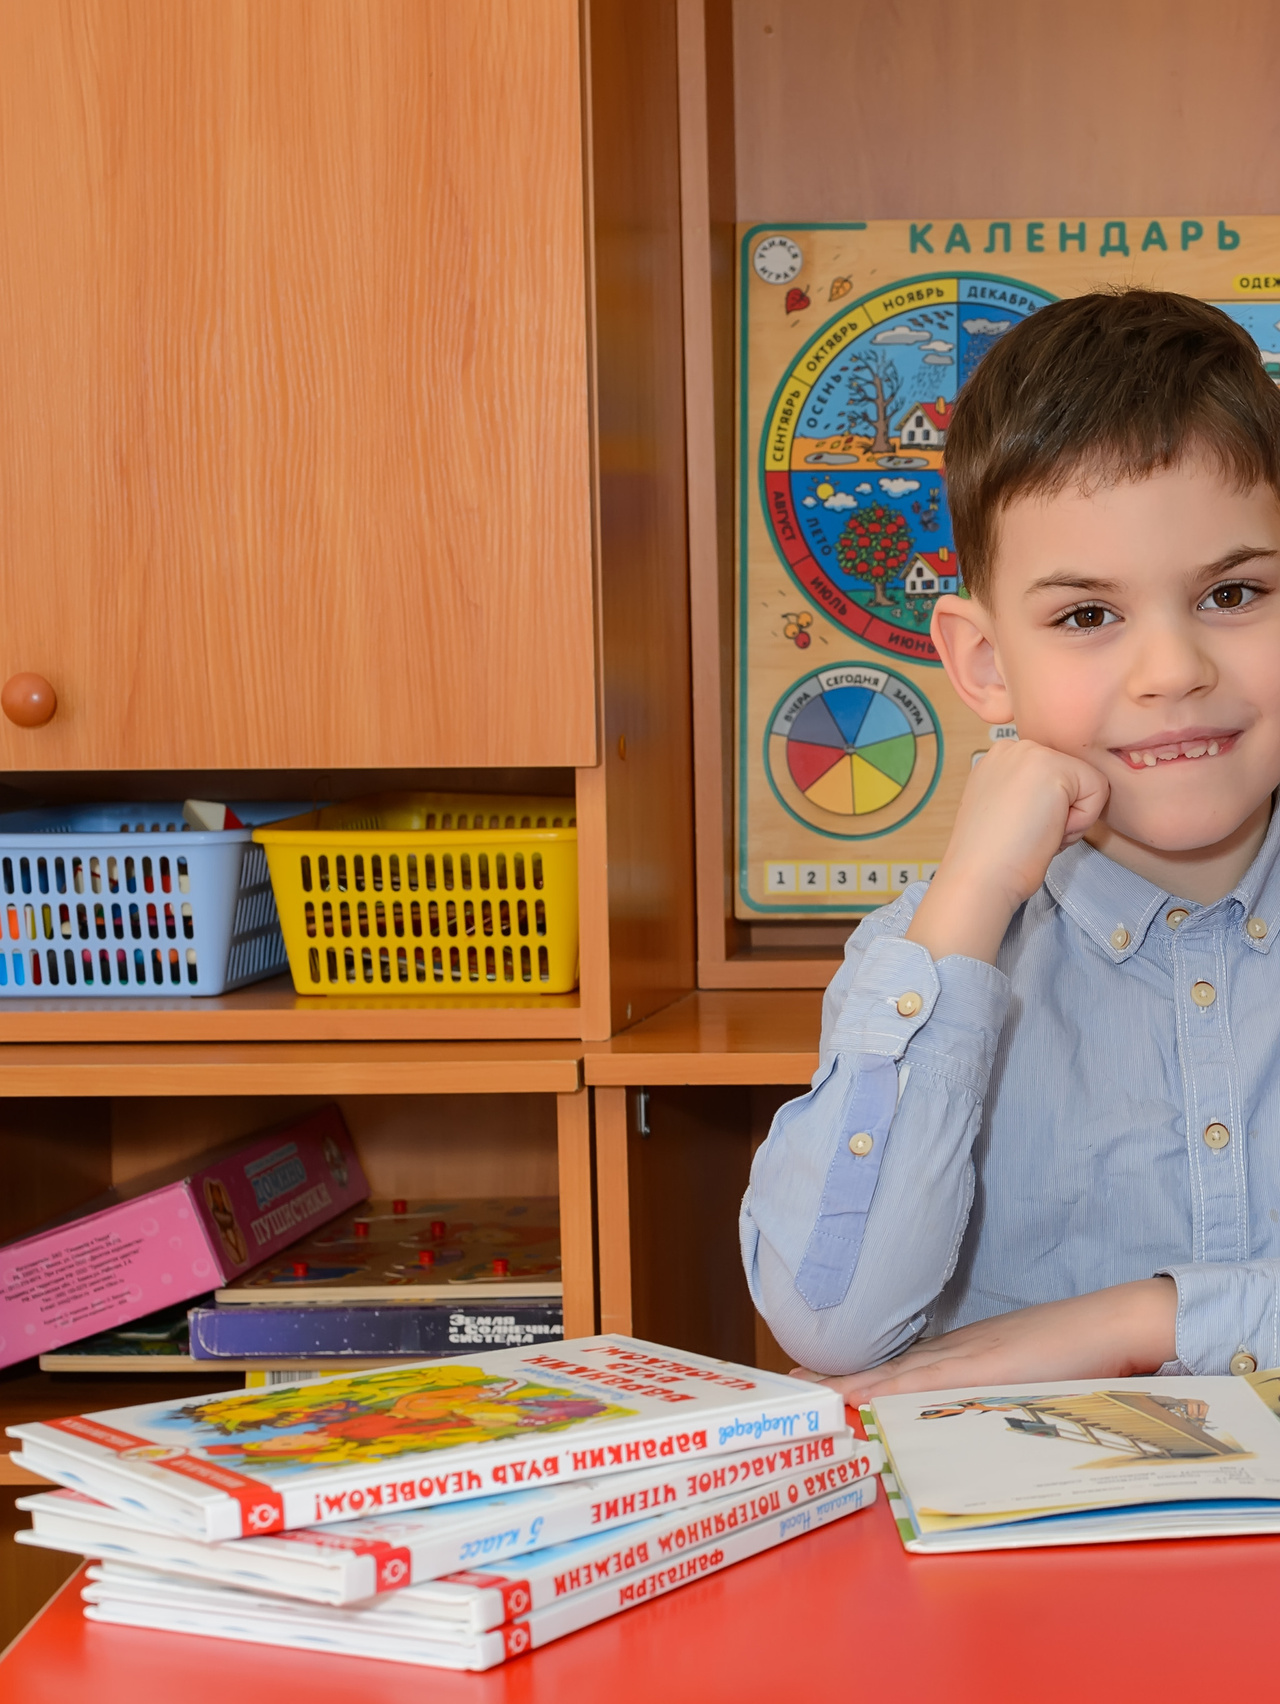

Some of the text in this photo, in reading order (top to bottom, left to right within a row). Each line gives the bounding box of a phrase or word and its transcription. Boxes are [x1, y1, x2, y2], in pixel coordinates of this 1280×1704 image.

[909, 219, 1240, 257] КАЛЕНДАРЬ
[883, 287, 944, 312] НОЯБРЬ
[967, 286, 1038, 313] ДЕКАБРЬ
[806, 321, 858, 373] ОКТЯБРЬ
[806, 374, 842, 428] ОСЕНЬ
[772, 389, 801, 462] СЕНТЯБРЬ
[772, 490, 797, 543] АВГУСТ
[806, 517, 832, 556] ЛЕТО
[810, 576, 848, 617] ИЮЛЬ
[888, 631, 936, 654] ИЮНЬ
[826, 674, 880, 688] СЕГОДНЯ
[783, 691, 811, 723] ВЧЕРА
[893, 688, 924, 727] ЗАВТРА
[776, 870, 908, 884] 1 2 3 4 5
[449, 1334, 534, 1344] СИСТЕМА
[464, 1325, 564, 1334] СОЛНЕЧНА
[718, 1412, 800, 1445] Медведев
[801, 1411, 819, 1432] В.
[492, 1456, 558, 1485] БУДЬ
[314, 1470, 482, 1521] ЧЕЛОВЕКОМ!
[459, 1436, 835, 1560] ВНЕКЛАССНОЕ ЧТЕНИЕ 5 класс
[817, 1488, 863, 1523] Николай
[554, 1456, 870, 1596] СКАЗКА О ПОТЕРЯННОМ ВРЕМЕНИ
[779, 1511, 811, 1538] Носов
